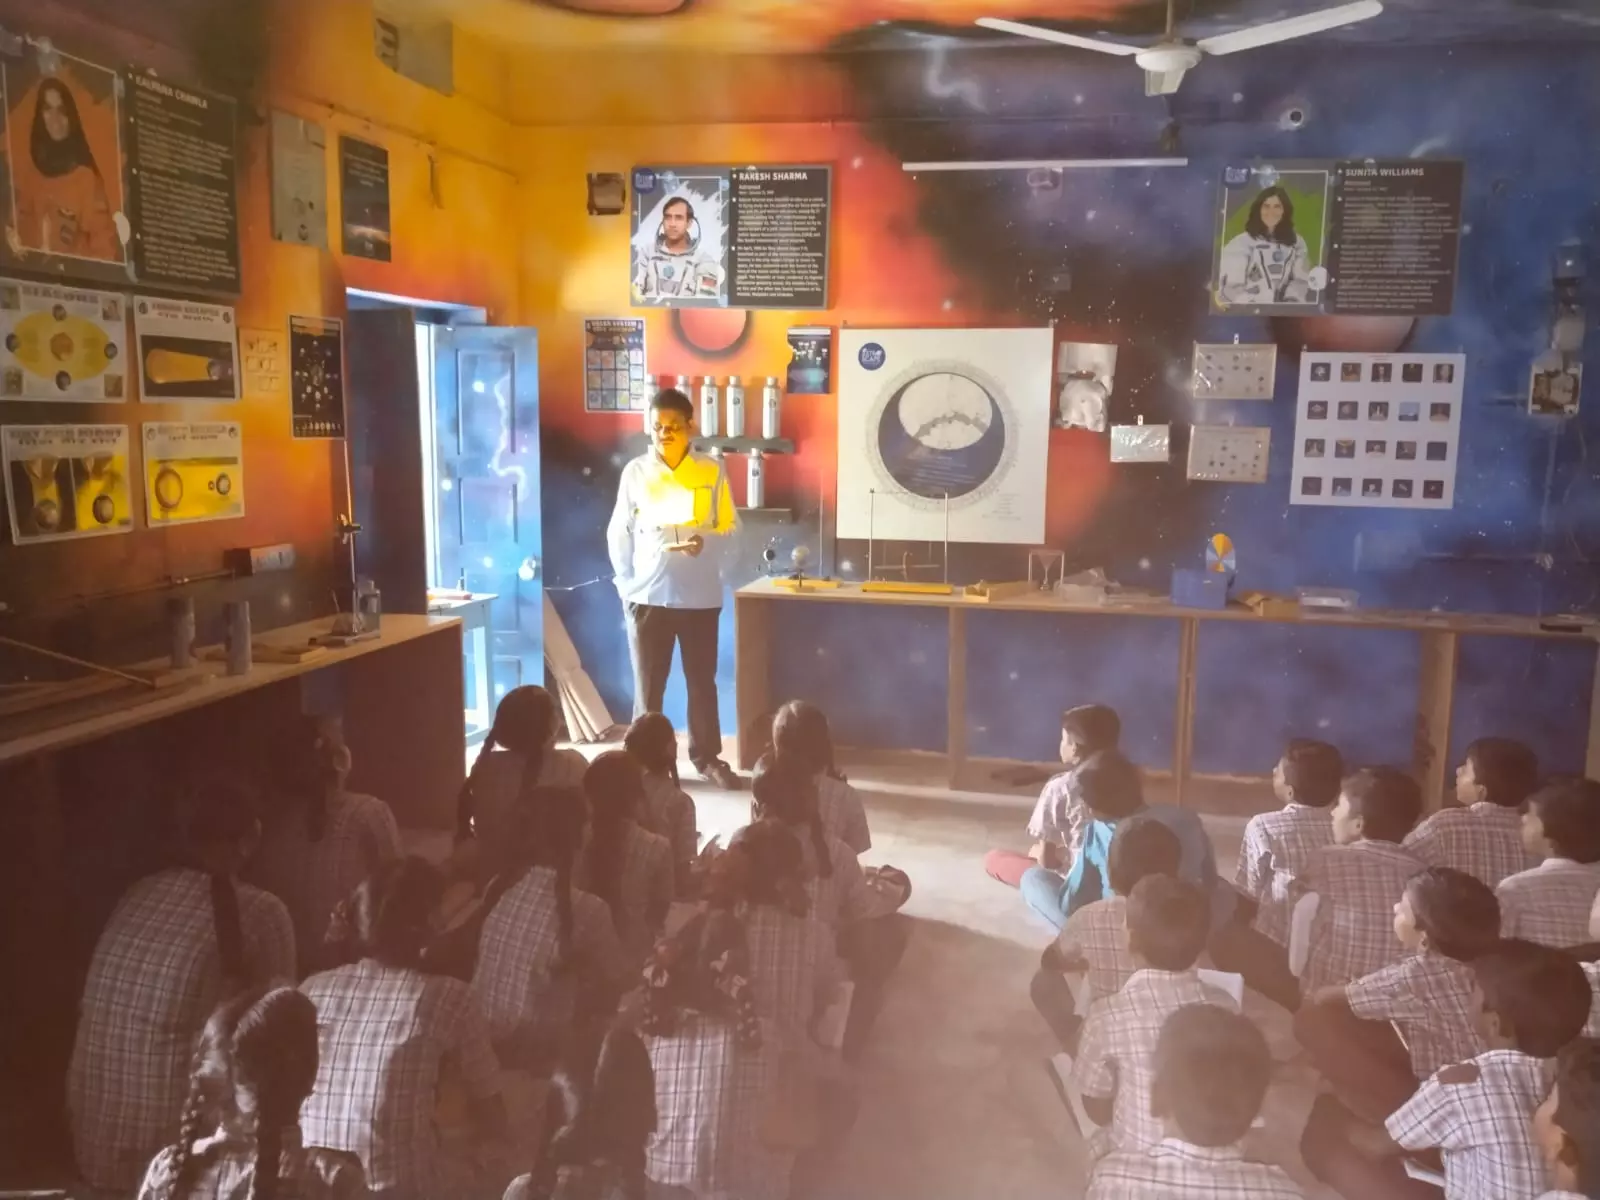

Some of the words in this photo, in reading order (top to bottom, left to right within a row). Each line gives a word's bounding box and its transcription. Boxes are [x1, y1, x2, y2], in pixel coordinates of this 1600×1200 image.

[739, 171, 771, 181] RAKESH
[773, 171, 808, 181] SHARMA
[1345, 167, 1378, 177] SUNITA
[1380, 167, 1425, 176] WILLIAMS
